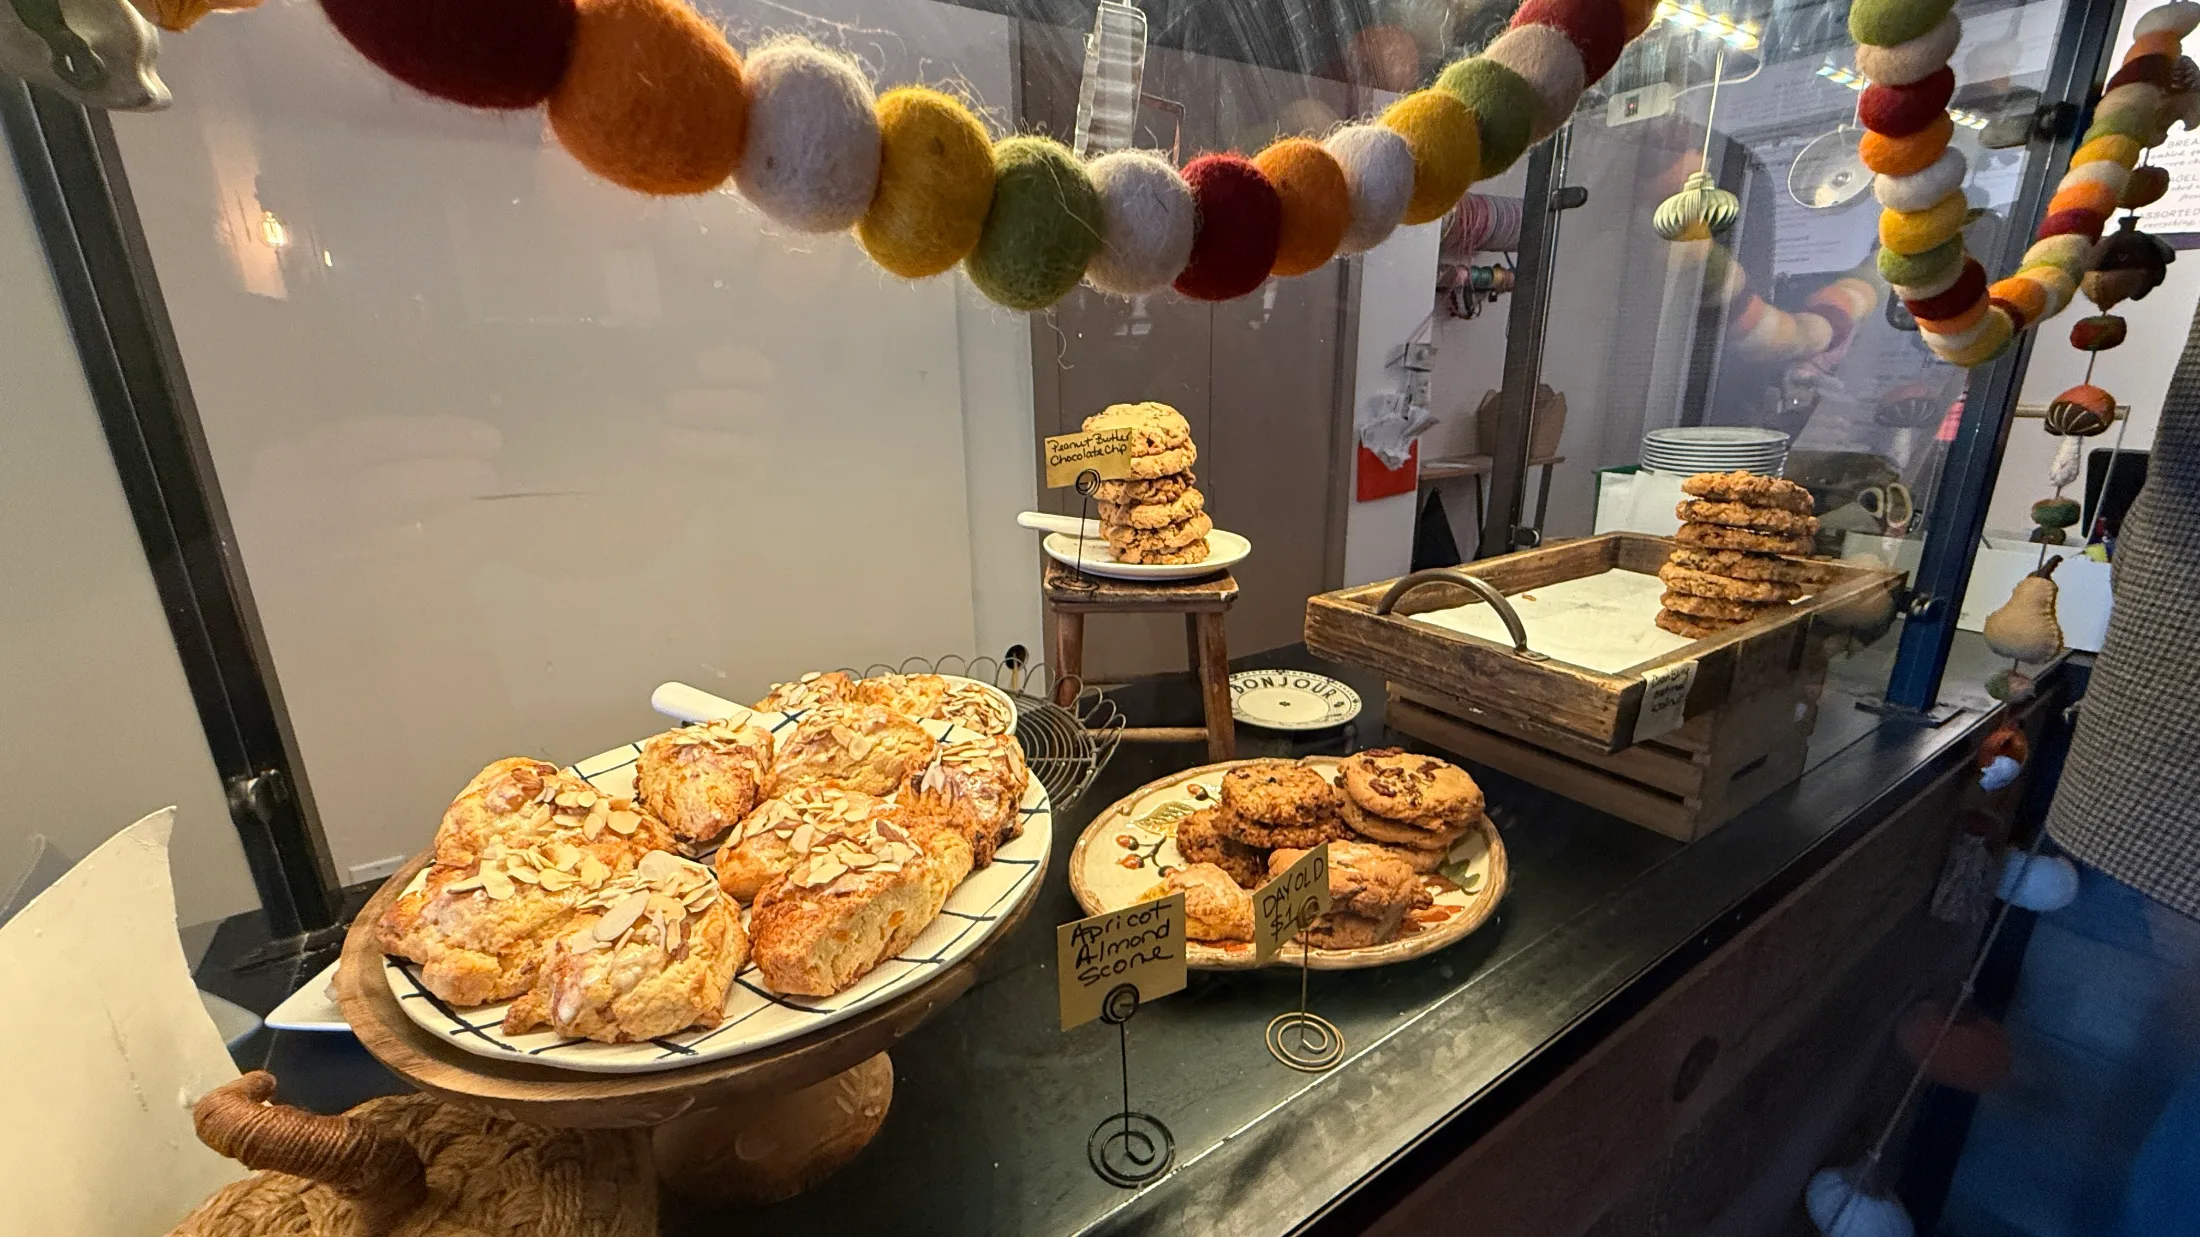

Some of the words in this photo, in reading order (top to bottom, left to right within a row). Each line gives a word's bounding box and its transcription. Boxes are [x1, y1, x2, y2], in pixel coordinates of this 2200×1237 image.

[2167, 138, 2200, 149] BREA
[1047, 438, 1093, 453] Peanut
[1092, 429, 1131, 445] Butter
[1050, 448, 1104, 466] Chocolate
[1104, 442, 1127, 455] Chip
[1230, 676, 1337, 699] BONJOUR
[1262, 873, 1292, 918] DAY
[1294, 857, 1324, 891] OLD
[1071, 900, 1172, 947] Apricot
[1076, 918, 1170, 969] Almond
[1077, 946, 1174, 987] Scone
